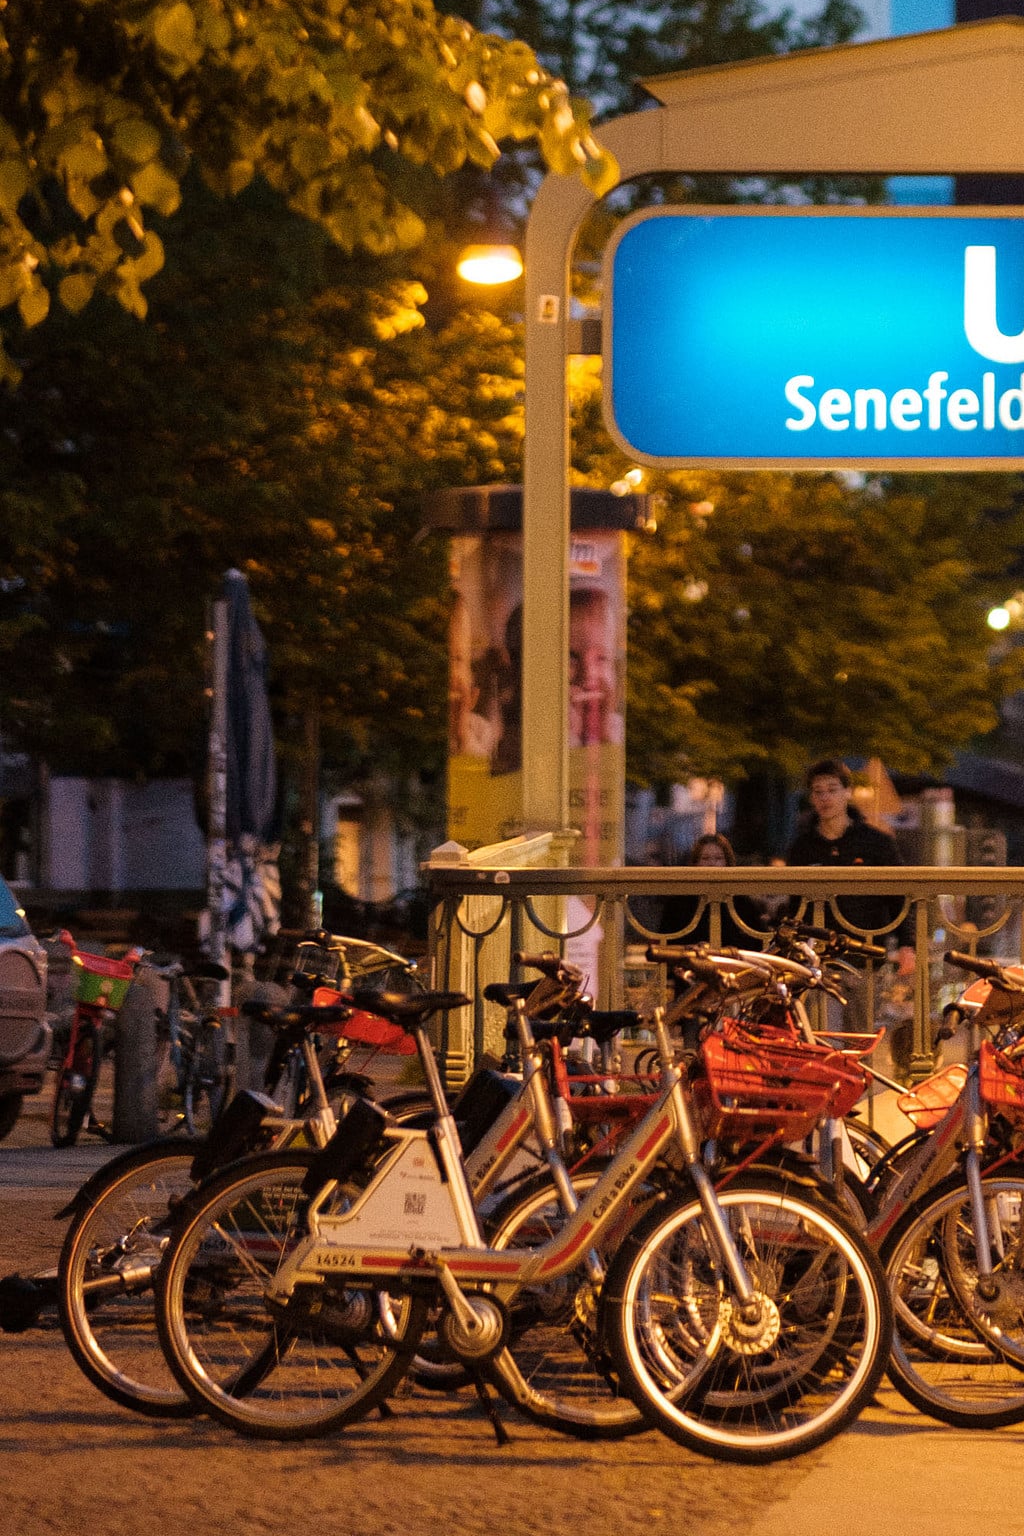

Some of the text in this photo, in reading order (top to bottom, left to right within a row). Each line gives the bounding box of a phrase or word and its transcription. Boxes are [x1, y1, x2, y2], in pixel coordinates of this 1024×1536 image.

[593, 1196, 612, 1218] Call
[614, 1165, 638, 1189] Bike
[316, 1253, 356, 1266] 14524
